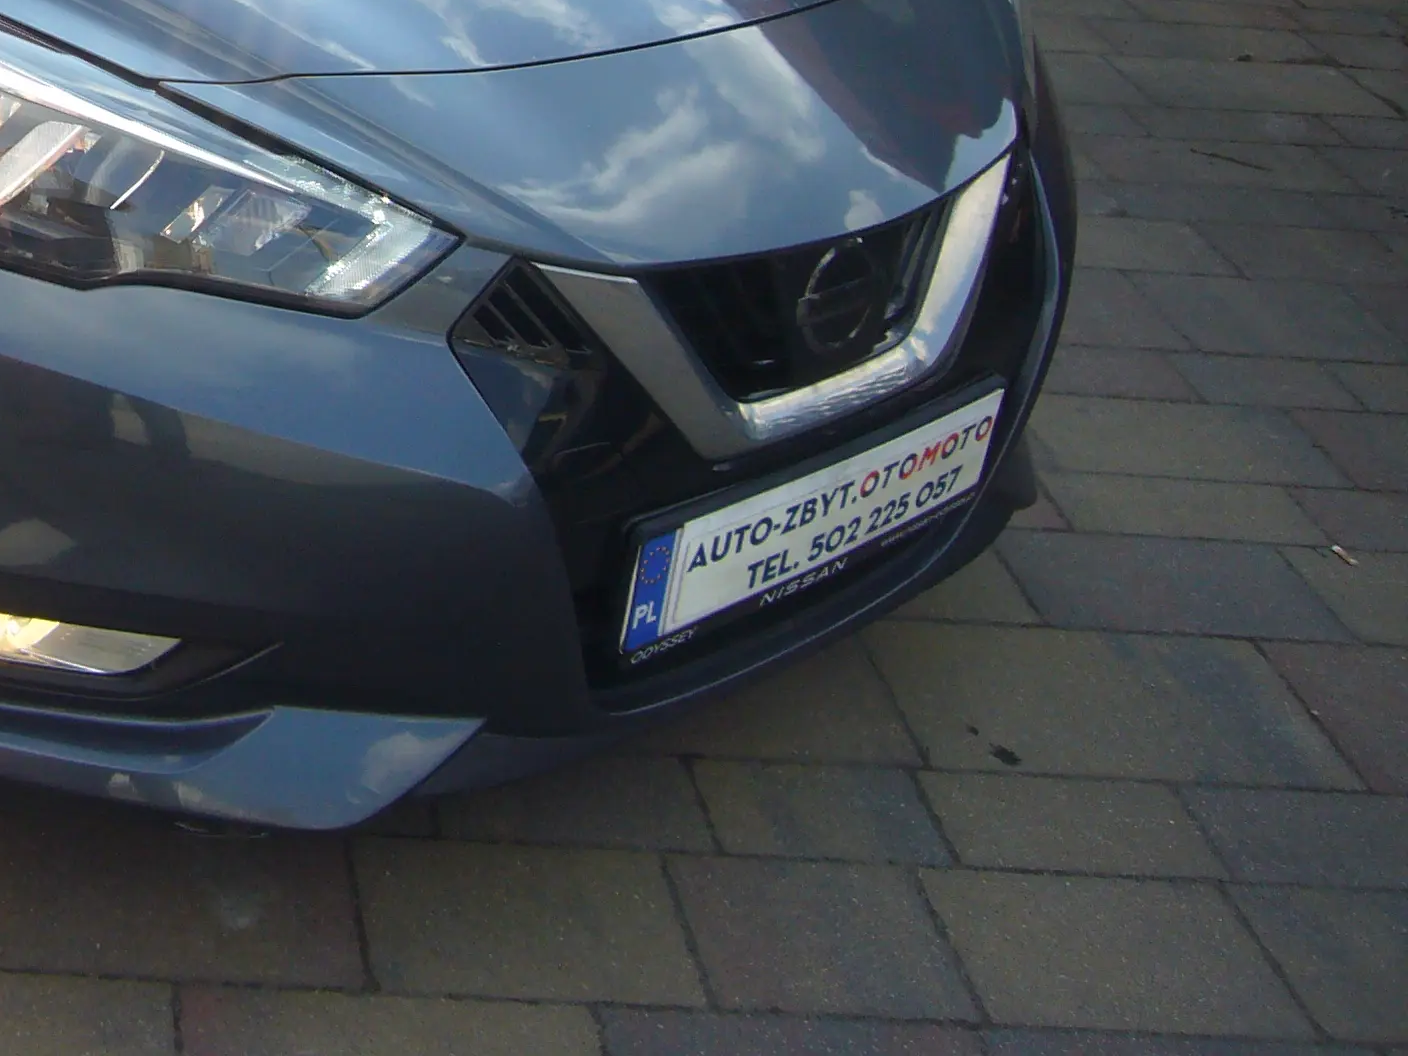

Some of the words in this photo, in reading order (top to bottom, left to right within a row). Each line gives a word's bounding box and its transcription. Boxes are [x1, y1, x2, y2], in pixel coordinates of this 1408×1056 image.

[687, 415, 993, 573] AUTO-ZBYT.OTOMOTO
[747, 550, 799, 589] TEL.
[808, 516, 862, 562] 502
[864, 491, 911, 536] 225
[632, 600, 657, 630] PL
[759, 557, 849, 606] NISSAN
